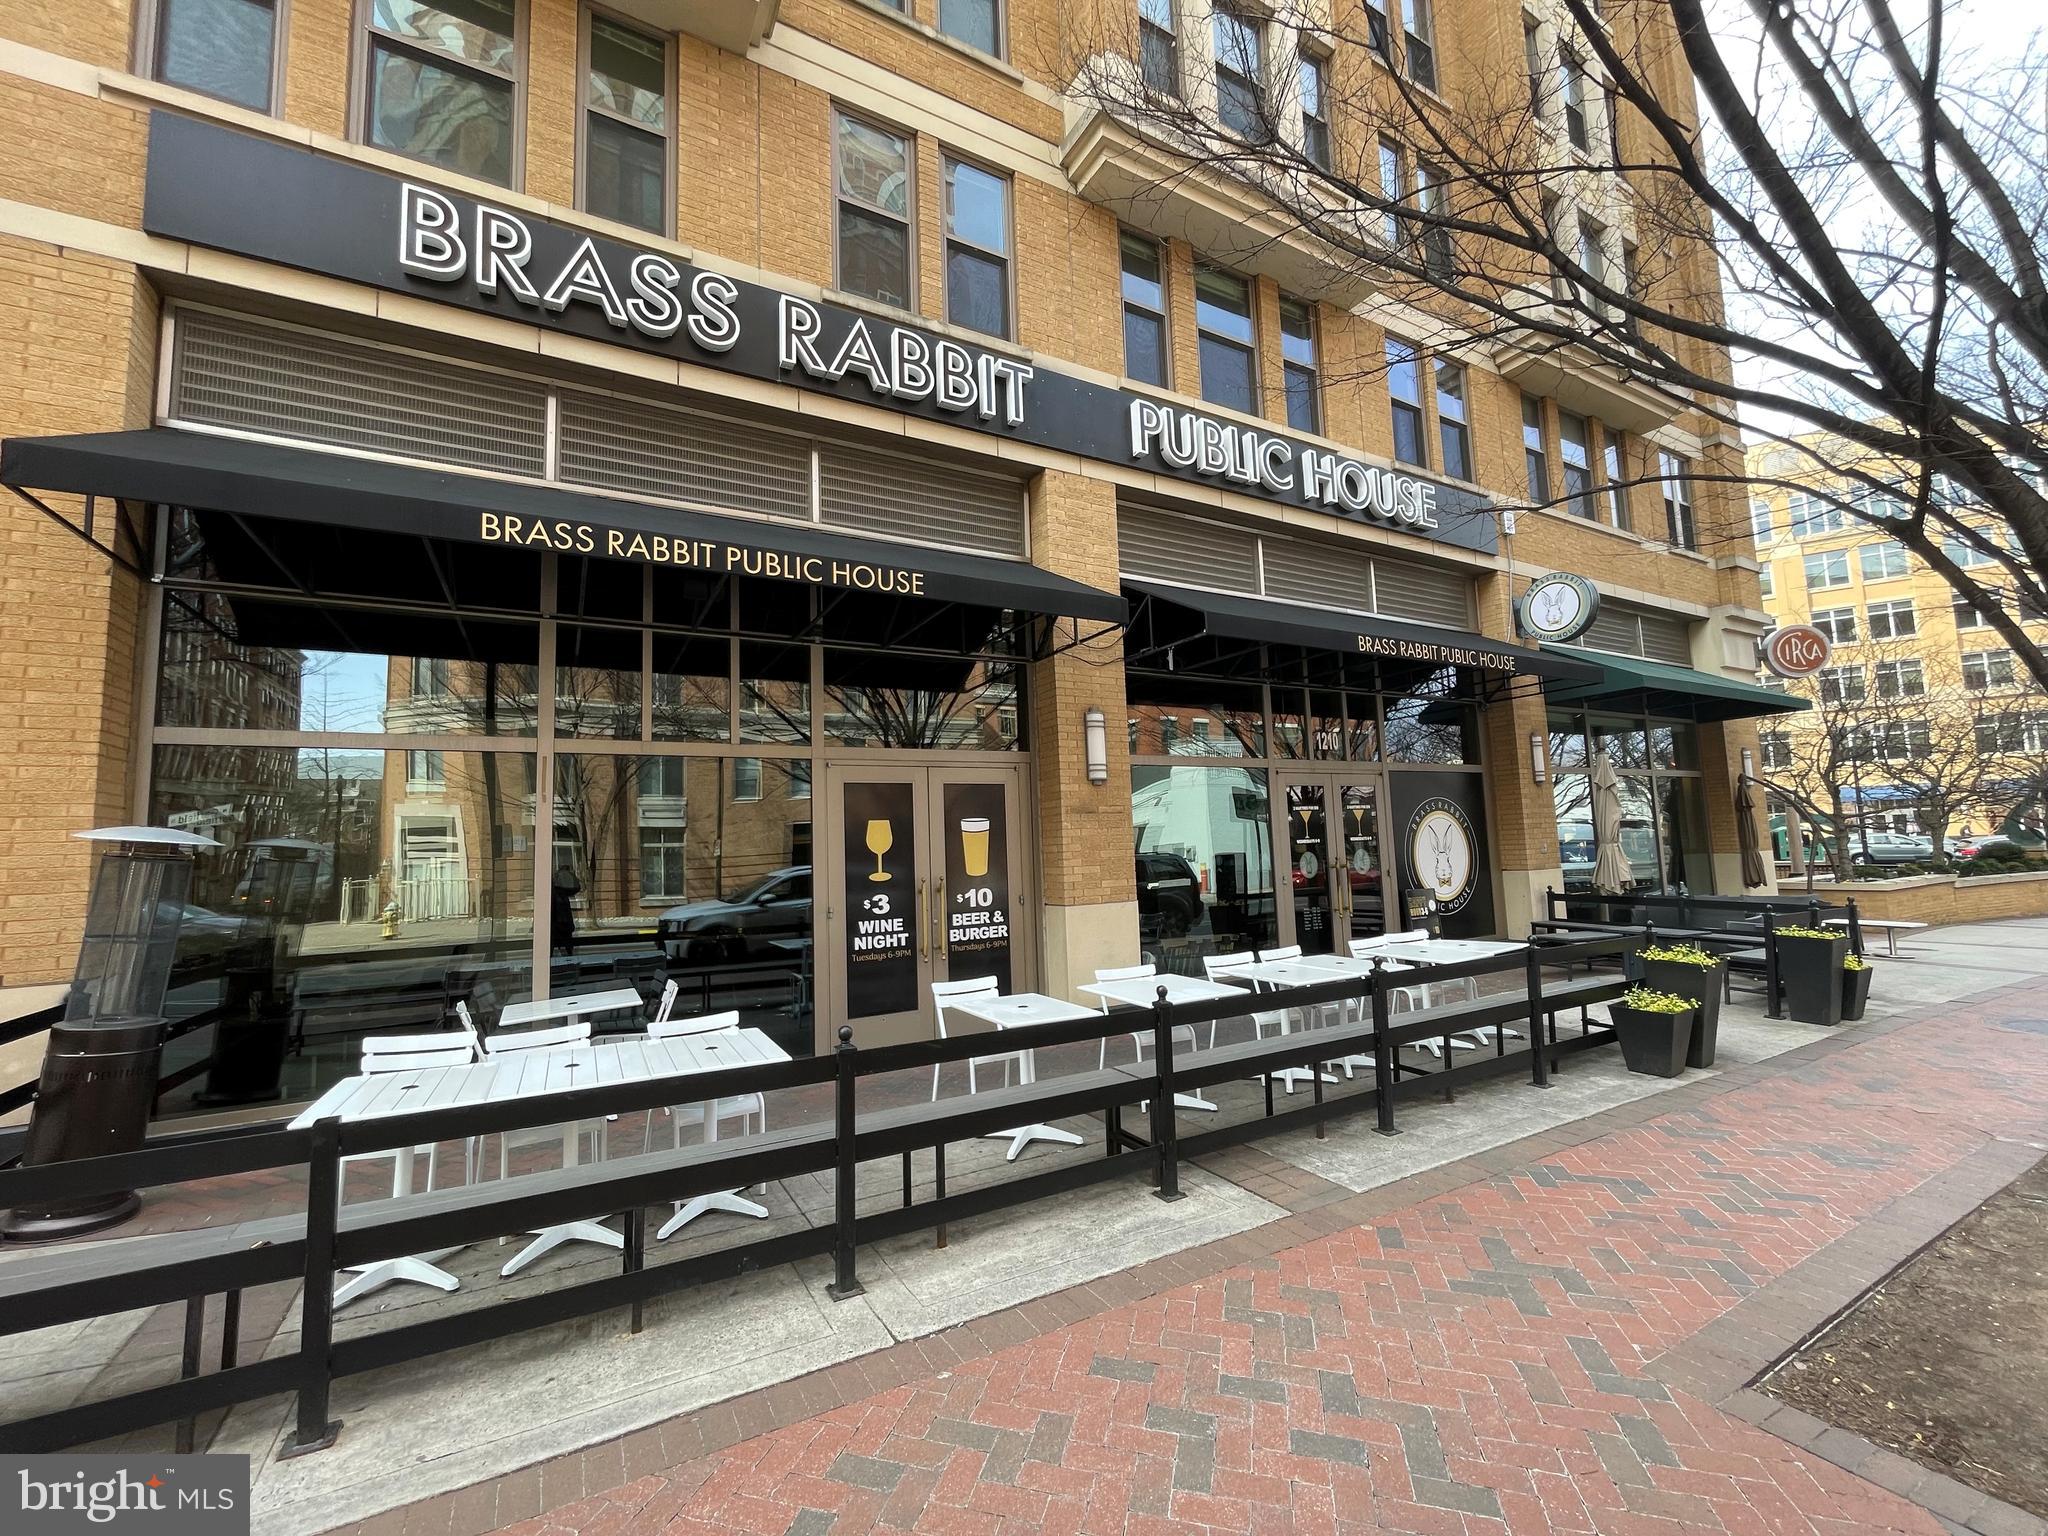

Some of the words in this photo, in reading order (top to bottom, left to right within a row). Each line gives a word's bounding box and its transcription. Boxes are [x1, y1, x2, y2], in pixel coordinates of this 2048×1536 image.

[400, 182, 741, 353] BRASS
[778, 293, 1034, 428] RABBIT
[1129, 398, 1294, 493] PUBLIC
[1300, 449, 1439, 531] HOUSE
[480, 511, 595, 554] BRASS
[606, 529, 717, 570] RABBIT
[726, 546, 824, 584] PUBLIC
[832, 562, 926, 596] HOUSE
[1531, 629, 1554, 641] PUBLIC
[1557, 622, 1581, 639] HOUSE
[1357, 635, 1397, 656] BRASS
[1400, 640, 1438, 661] RABBIT
[1440, 646, 1477, 666] PUBLIC
[1479, 652, 1516, 671] HOUSE
[1777, 632, 1823, 670] CIRCA
[1316, 731, 1339, 750] 1210
[1411, 802, 1436, 830] BRASS
[1438, 801, 1468, 829] RABBIT
[863, 894, 890, 915] $3
[956, 887, 993, 908] $10
[1448, 886, 1471, 910] HOUSE
[858, 918, 904, 934] WINE
[952, 912, 991, 926] BEER
[993, 910, 1004, 923] &
[854, 933, 909, 950] NIGHT
[950, 925, 1008, 942] BURGER
[852, 952, 886, 962] Tuesdays
[887, 949, 912, 959] 6-9PM
[951, 943, 985, 952] Thursdays
[986, 940, 1008, 949] 6-9PM
